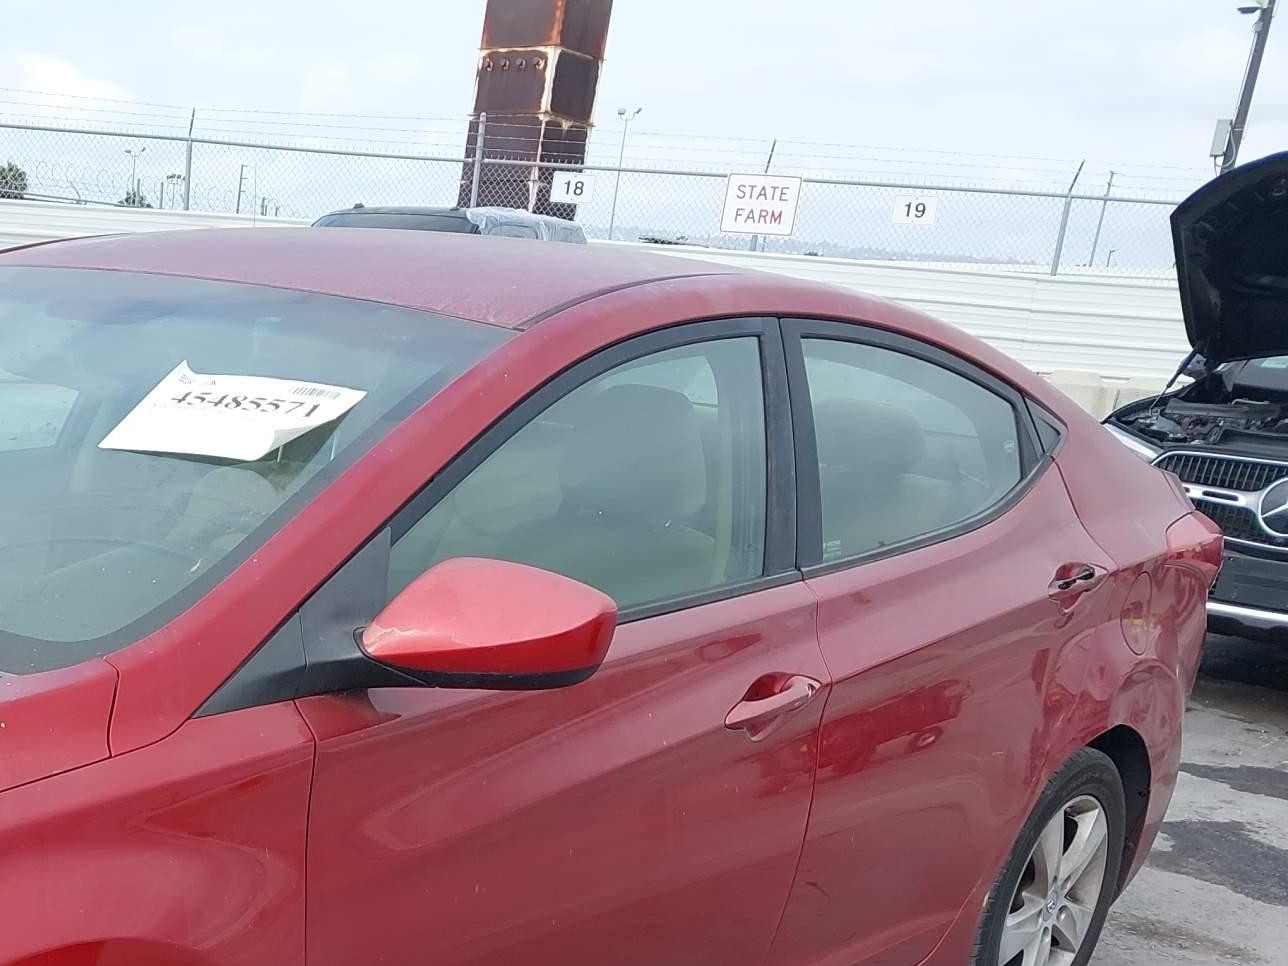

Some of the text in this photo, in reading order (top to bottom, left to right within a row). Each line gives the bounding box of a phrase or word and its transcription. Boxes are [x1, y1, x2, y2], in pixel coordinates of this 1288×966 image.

[564, 180, 584, 196] 18
[736, 184, 790, 202] STATE
[734, 208, 783, 225] FARM
[904, 201, 926, 218] 19
[171, 391, 320, 418] 45485571
